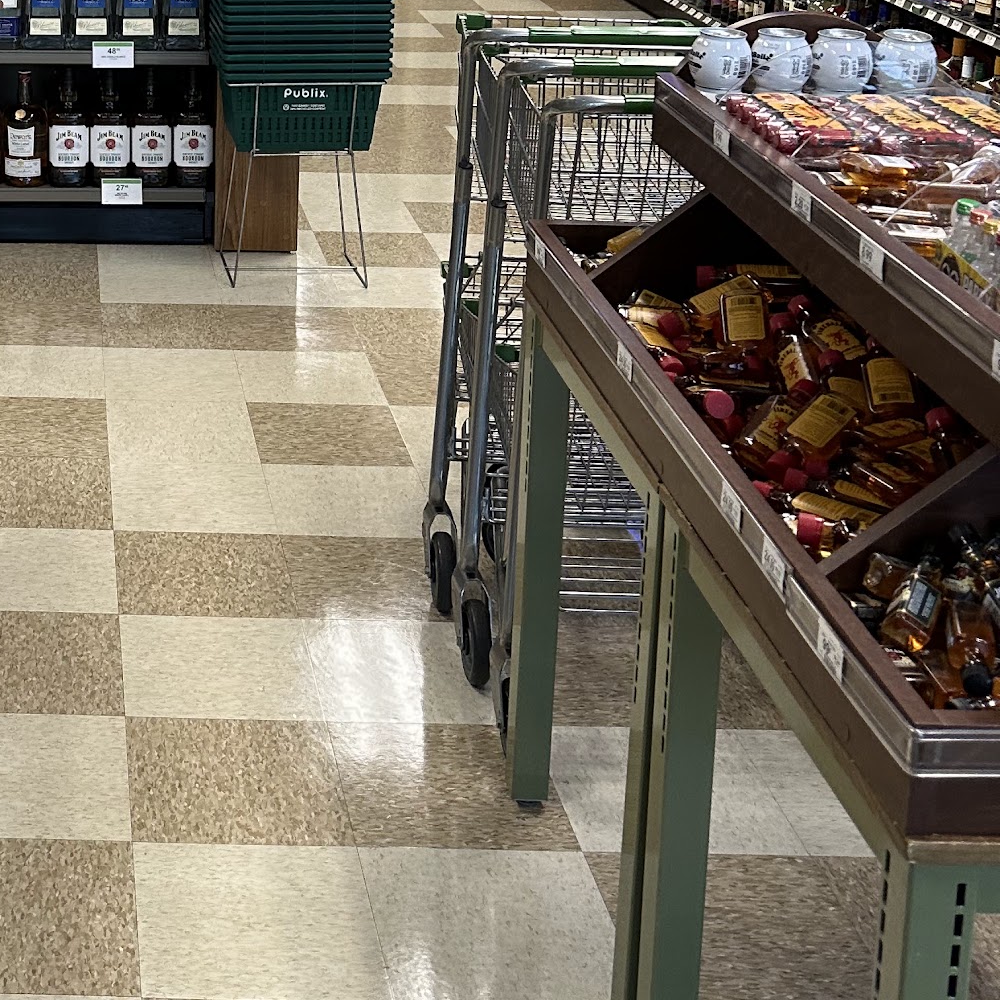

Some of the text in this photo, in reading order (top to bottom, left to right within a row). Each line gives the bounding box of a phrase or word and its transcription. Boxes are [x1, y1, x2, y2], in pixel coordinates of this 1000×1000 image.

[56, 130, 82, 141] JIM BEAM
[97, 130, 124, 141] JIM BEAM
[139, 130, 166, 141] JIM BEAM
[180, 130, 207, 140] JIM BEAM
